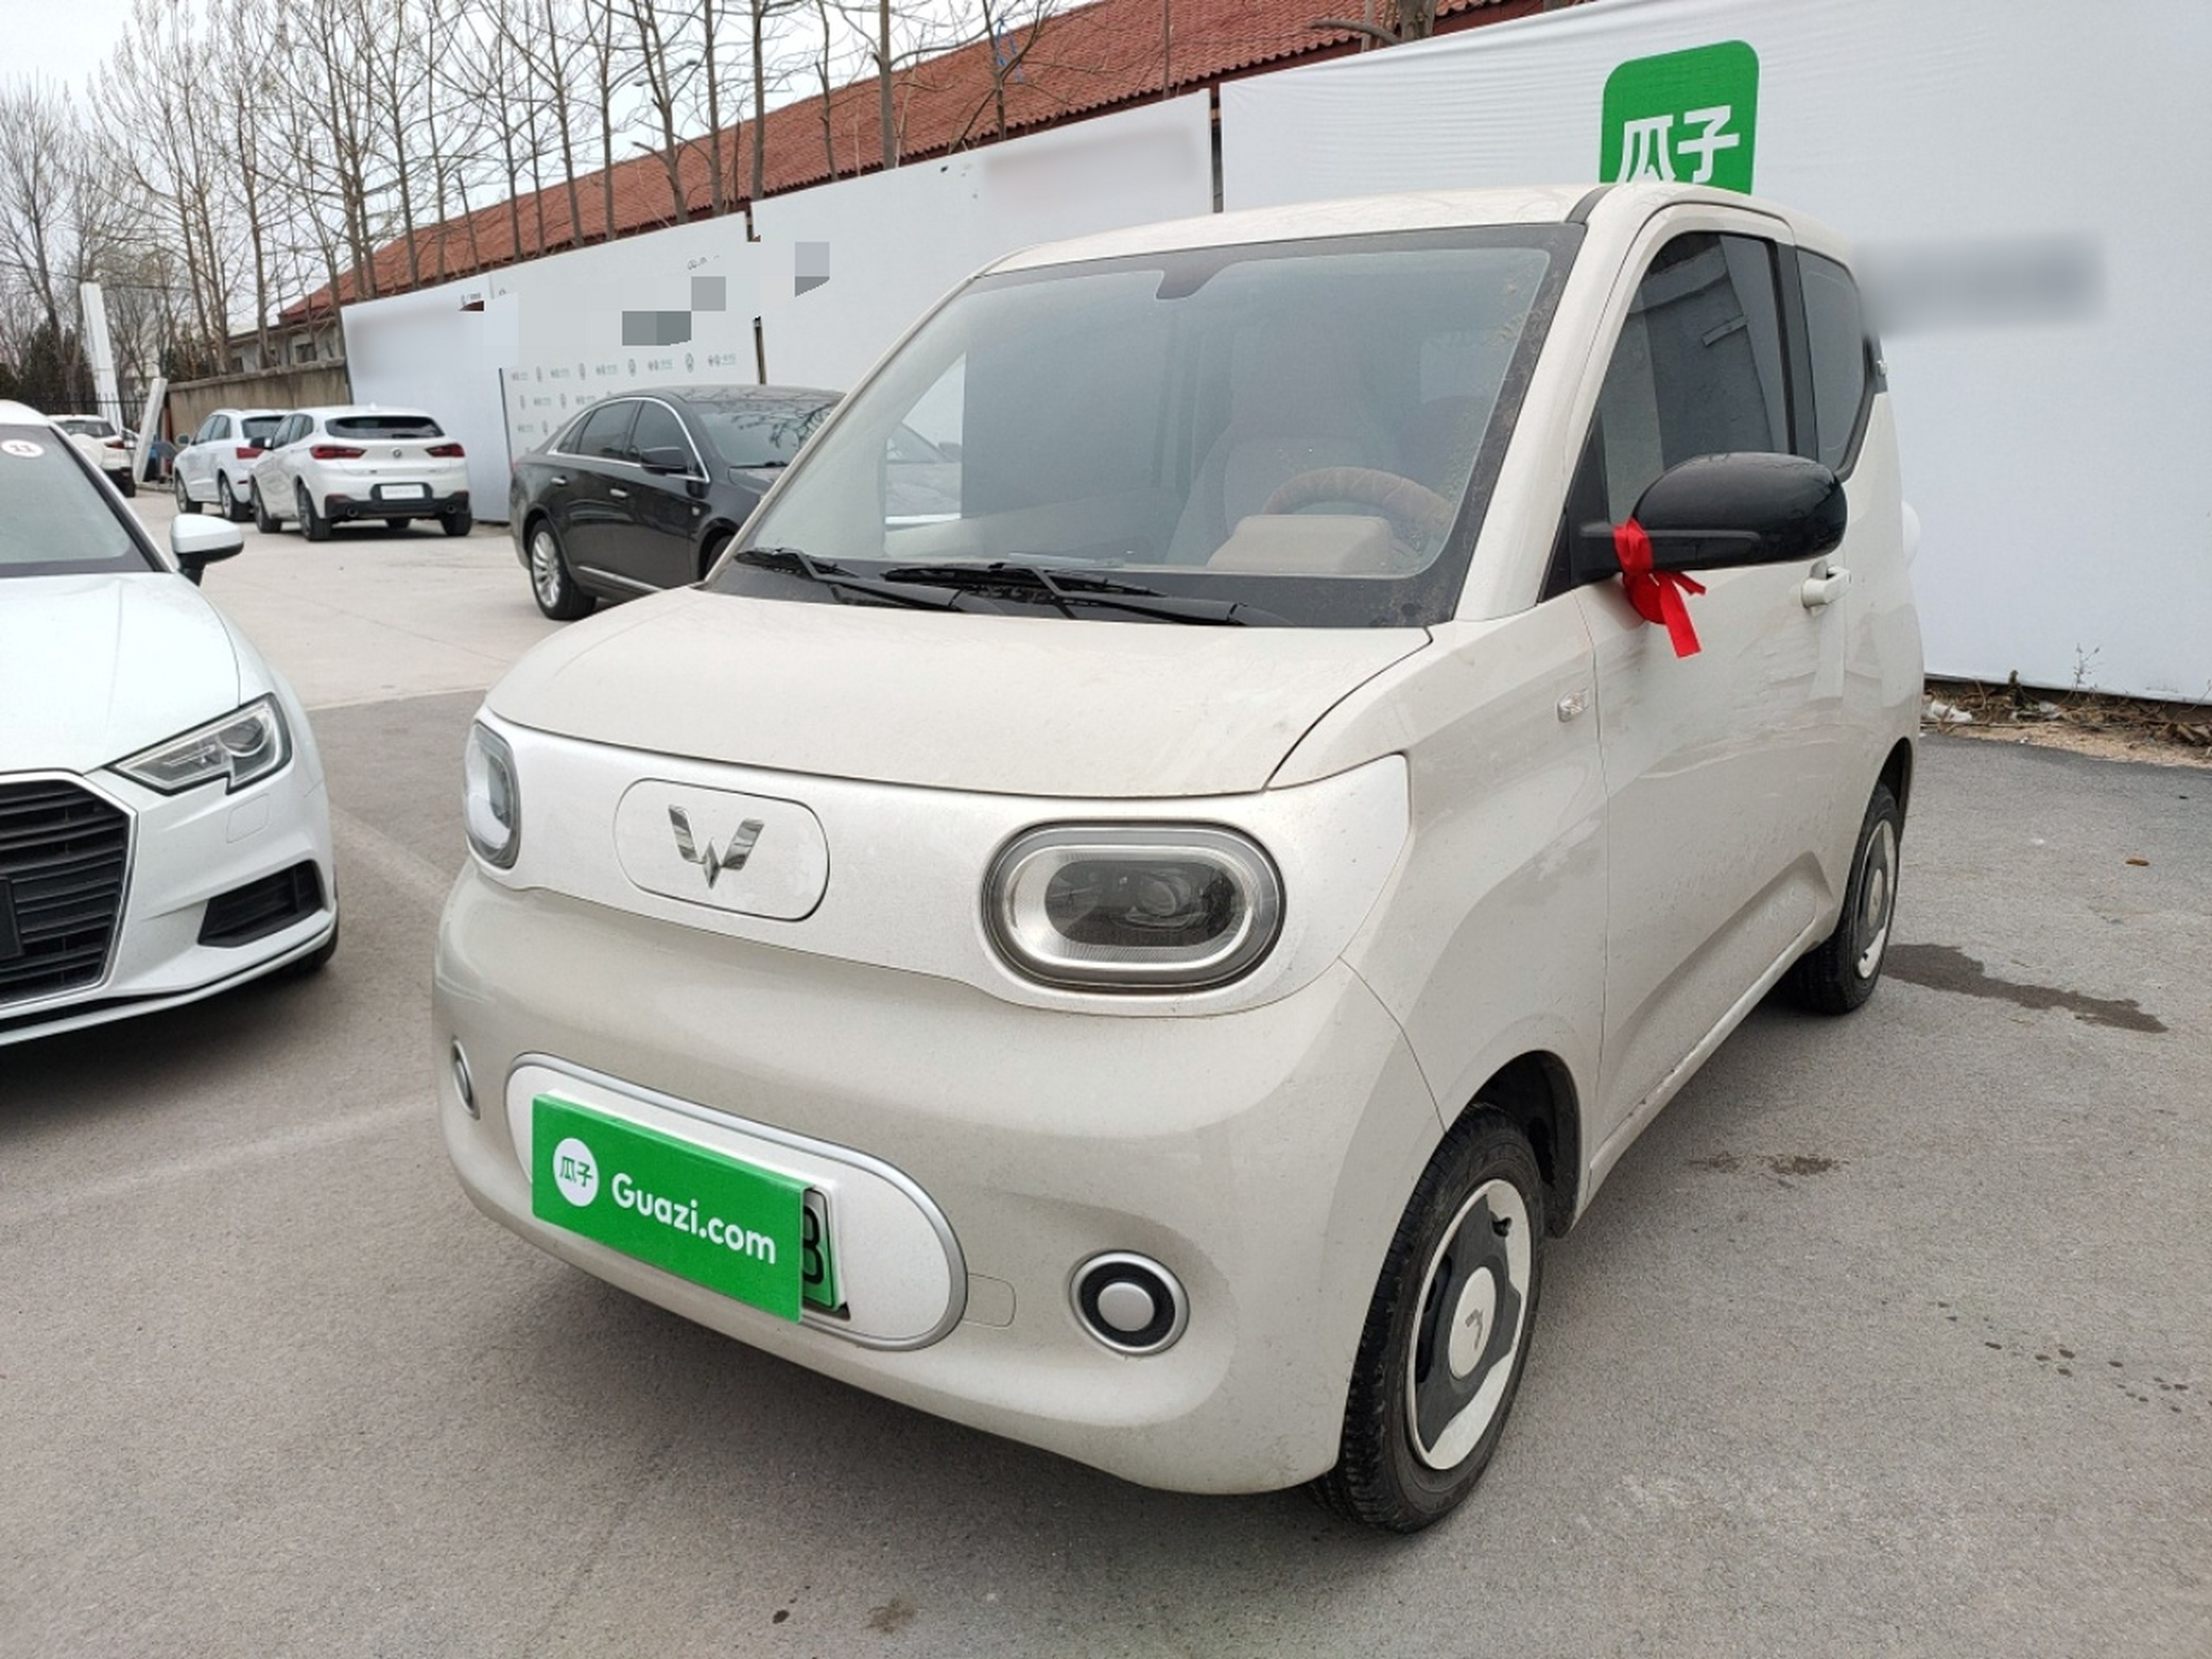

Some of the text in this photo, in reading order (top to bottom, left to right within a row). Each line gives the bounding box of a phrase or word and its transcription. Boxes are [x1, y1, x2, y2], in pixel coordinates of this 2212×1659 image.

[1617, 105, 1740, 183] 瓜子
[559, 1156, 593, 1187] 瓜子
[612, 1173, 776, 1264] Guazi.com
